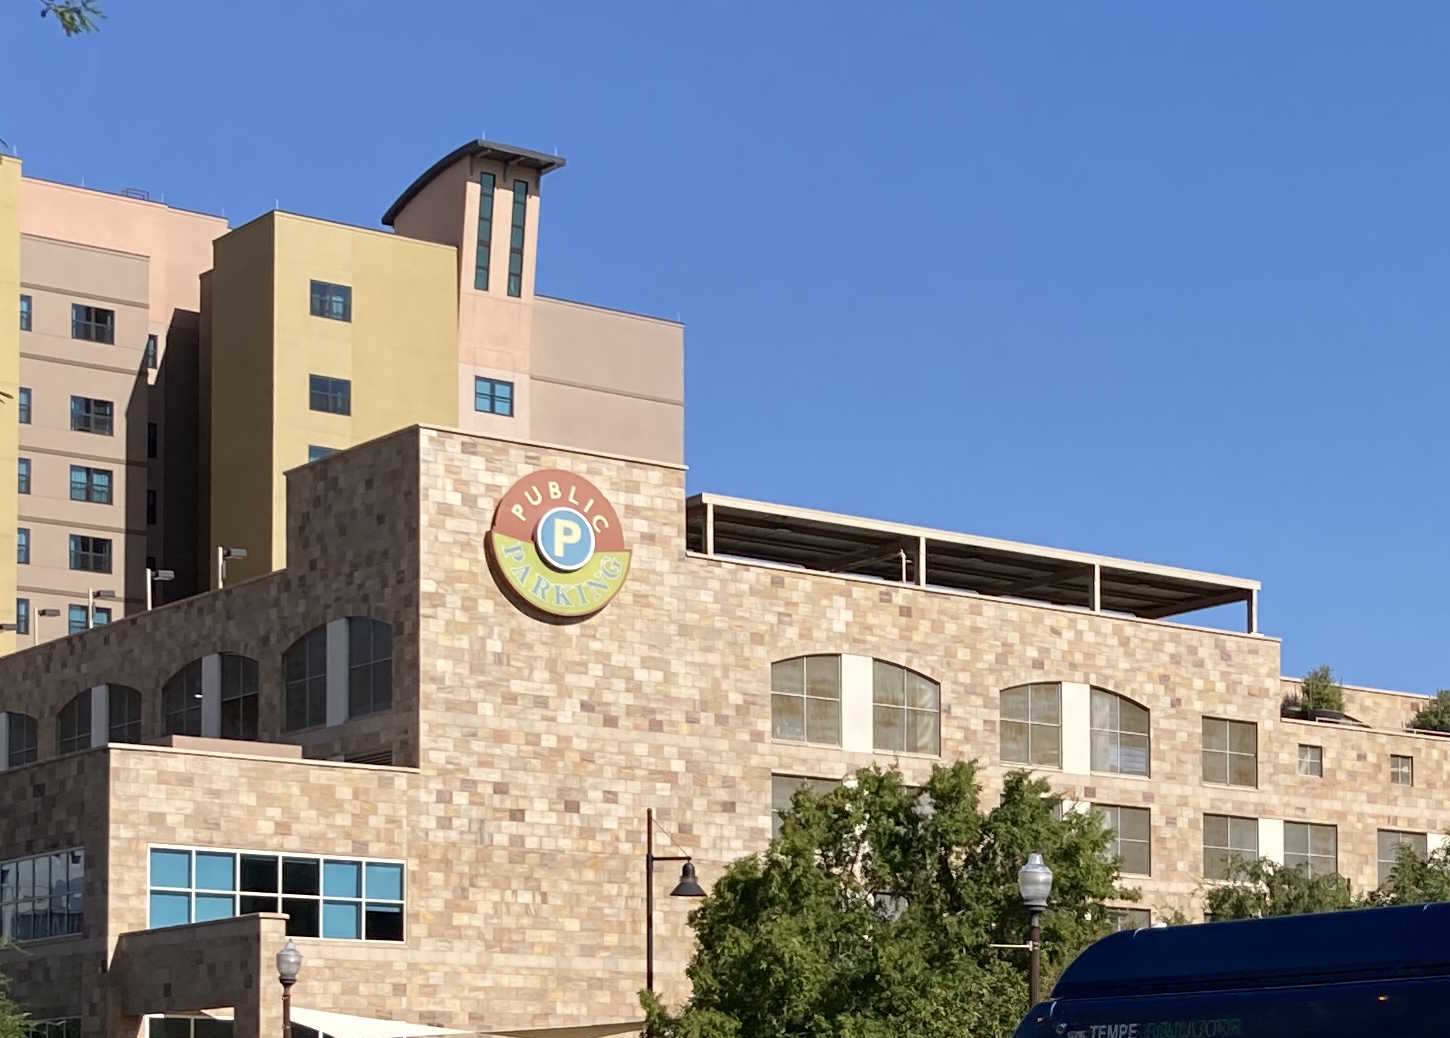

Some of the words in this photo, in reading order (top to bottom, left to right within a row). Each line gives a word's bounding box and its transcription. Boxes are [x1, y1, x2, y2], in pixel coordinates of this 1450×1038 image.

[511, 481, 609, 533] PUBLIC
[553, 518, 581, 557] P
[503, 544, 621, 607] PARKING
